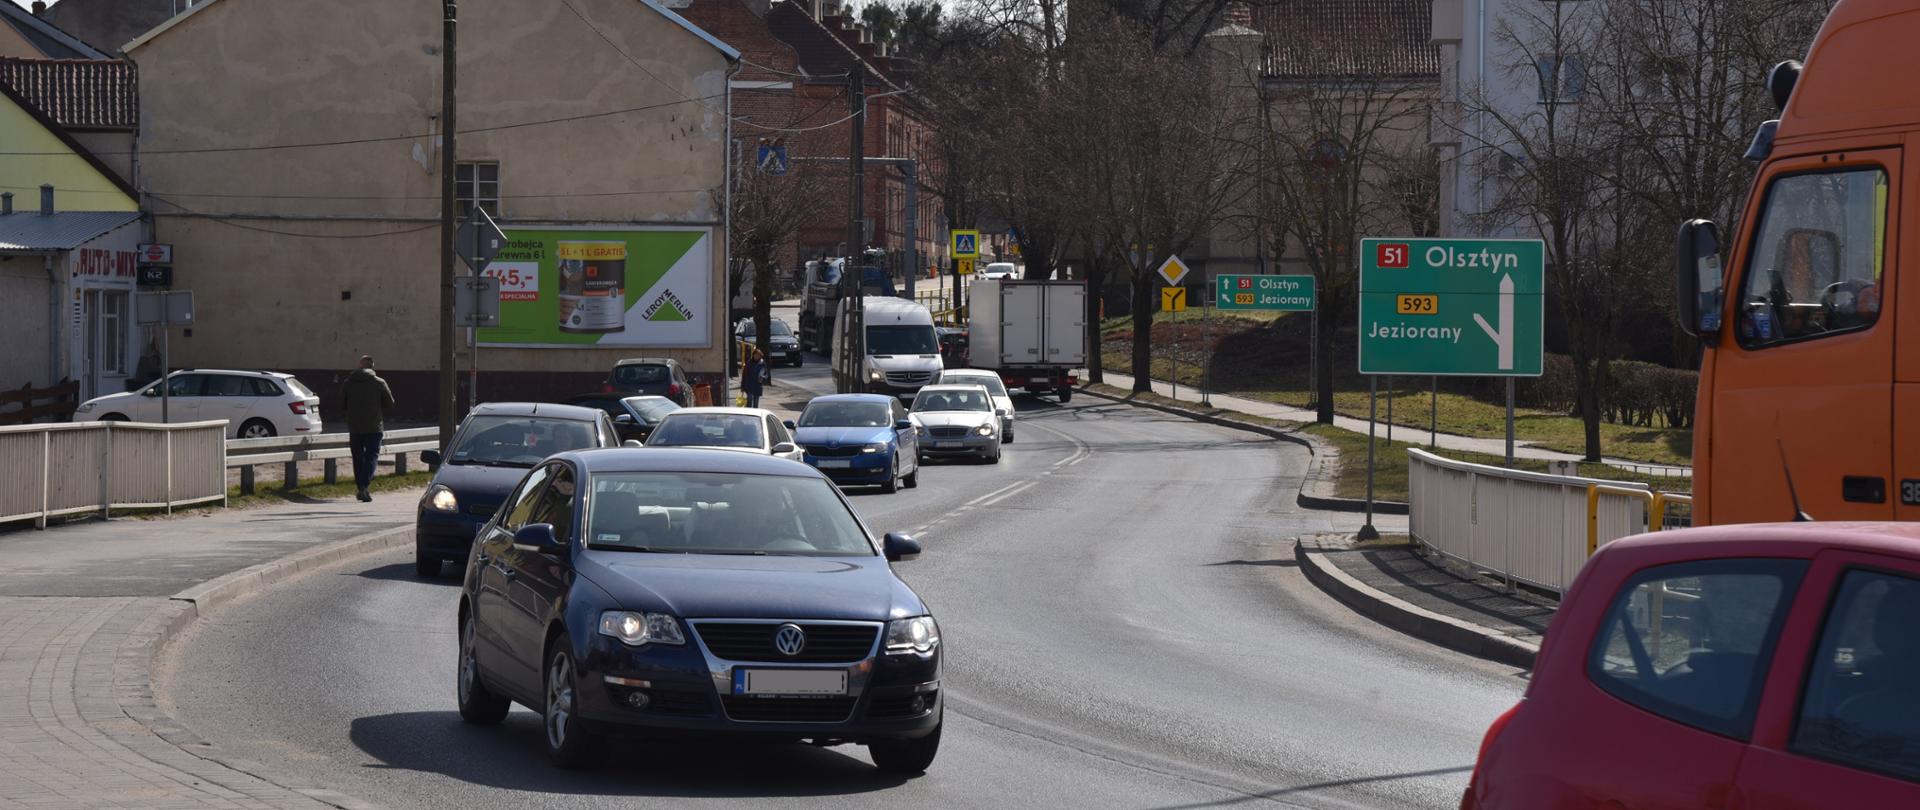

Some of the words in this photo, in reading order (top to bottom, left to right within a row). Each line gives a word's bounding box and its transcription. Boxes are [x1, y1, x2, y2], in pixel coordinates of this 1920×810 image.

[1384, 248, 1402, 264] 51
[1426, 246, 1518, 273] Olsztyn
[147, 271, 163, 279] K2
[1260, 279, 1299, 292] Olsztyn
[642, 294, 666, 320] LEROY
[663, 289, 694, 320] MERLIN
[1237, 295, 1253, 303] 593
[1260, 294, 1311, 307] Jeziorany
[1403, 298, 1432, 311] 593
[1368, 322, 1462, 343] Jeziorany
